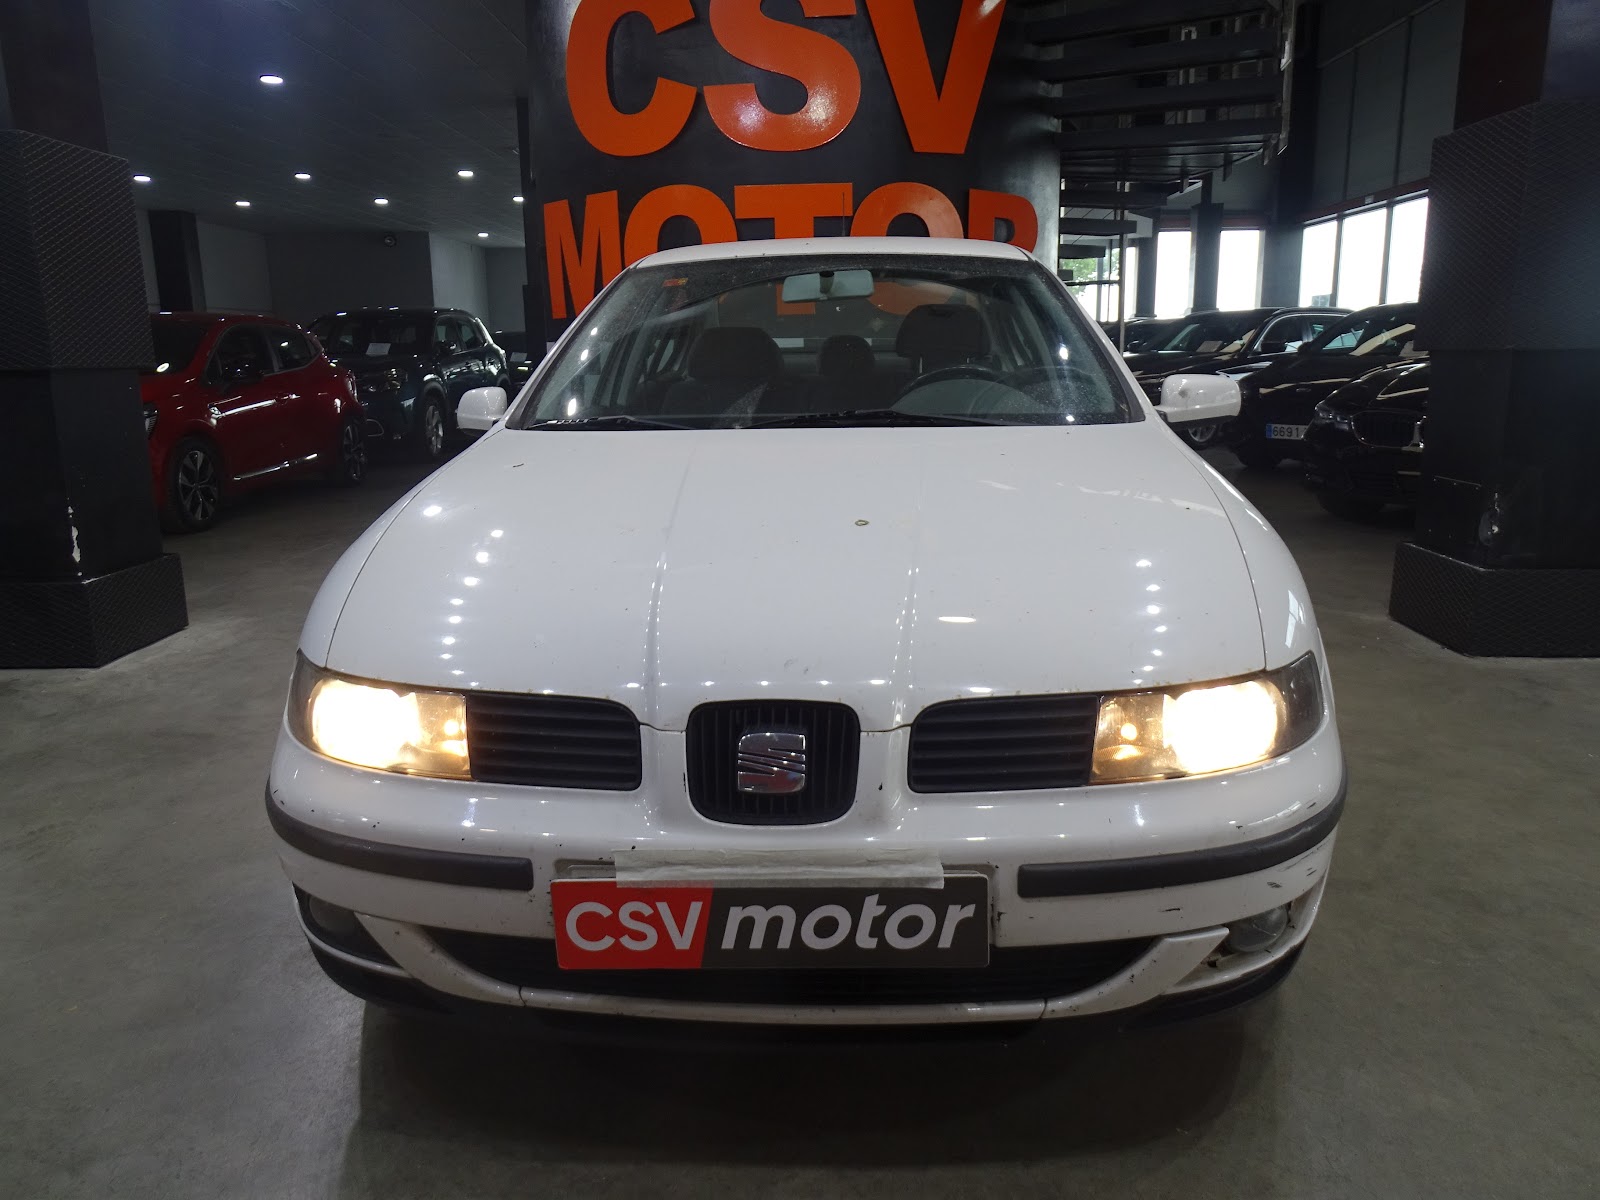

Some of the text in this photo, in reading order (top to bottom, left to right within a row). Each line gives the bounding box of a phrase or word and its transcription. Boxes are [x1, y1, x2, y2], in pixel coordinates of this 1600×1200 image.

[565, 0, 1006, 157] CSV
[1272, 426, 1300, 438] 6691
[565, 893, 977, 952] CSV motor
